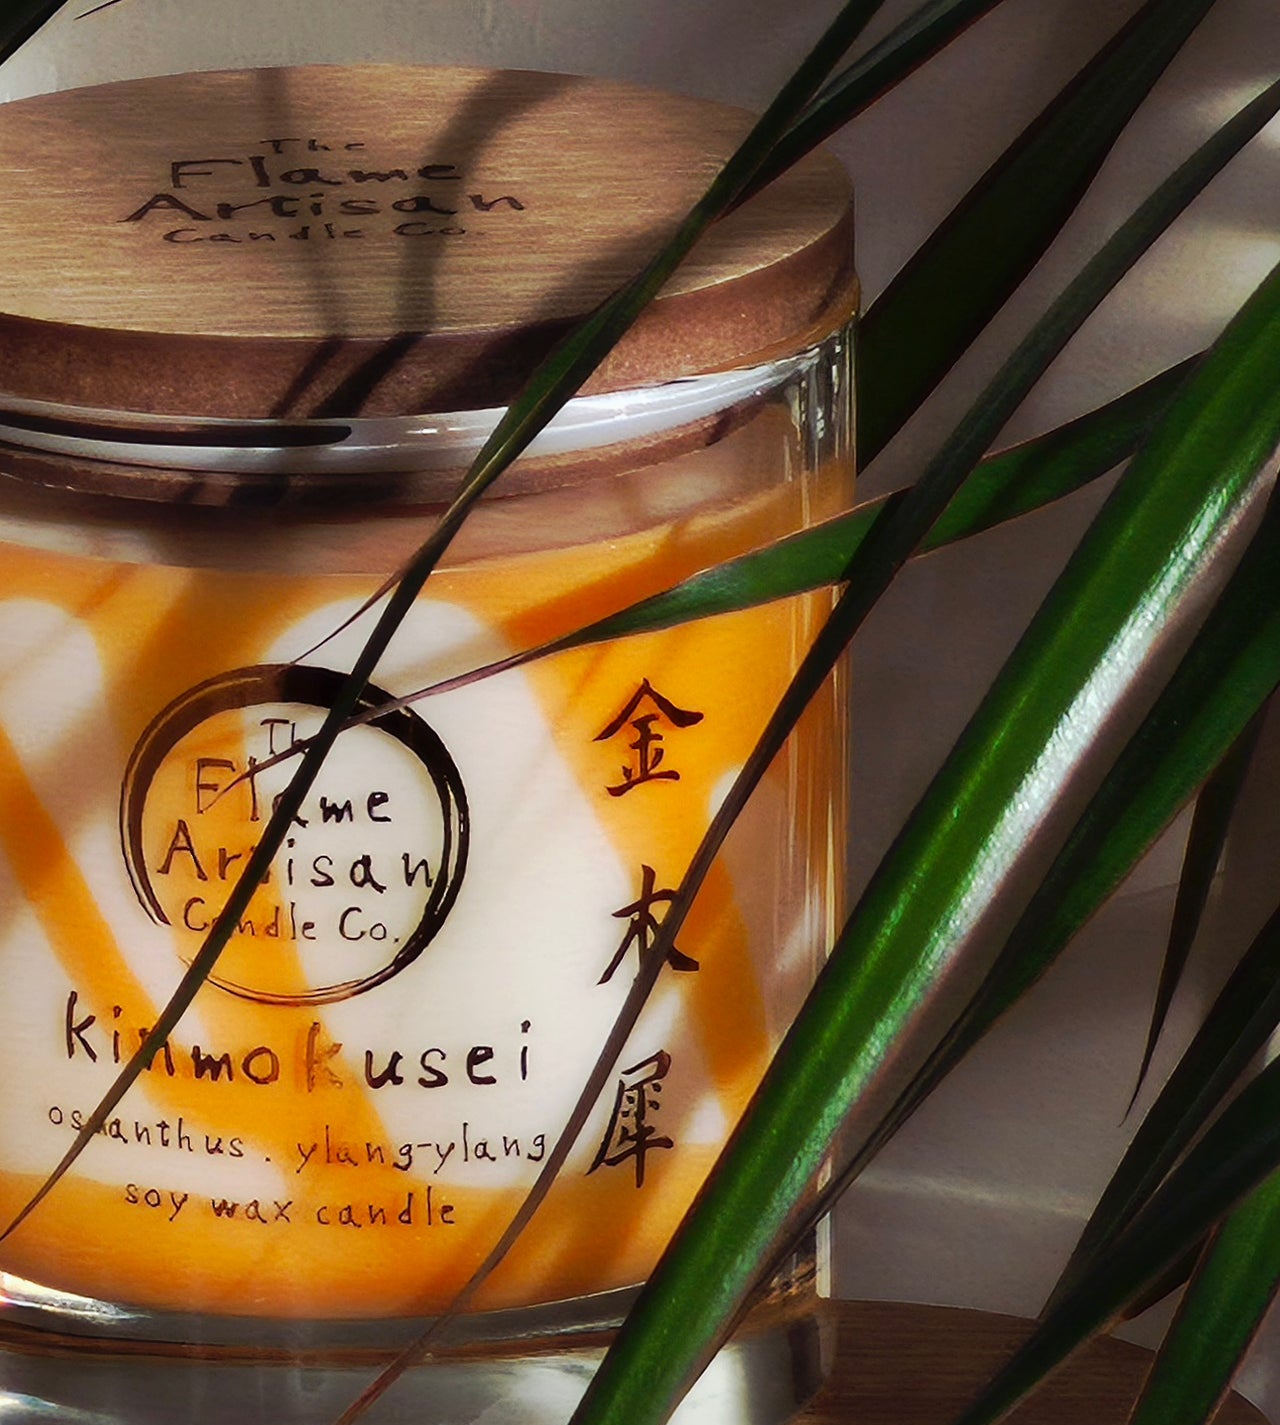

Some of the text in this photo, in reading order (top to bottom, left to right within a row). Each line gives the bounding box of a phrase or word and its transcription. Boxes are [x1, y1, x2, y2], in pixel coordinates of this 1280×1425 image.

[259, 137, 366, 154] The
[170, 155, 462, 189] Flame
[115, 193, 526, 224] Artisan
[162, 222, 366, 244] Candle
[259, 718, 310, 756] Th
[156, 818, 436, 895] Arisan
[183, 896, 401, 944] Cndle Co.
[64, 990, 534, 1094] kinmokusei
[295, 1121, 548, 1175] ylang-ylang
[123, 1180, 457, 1228] soy wax candle
